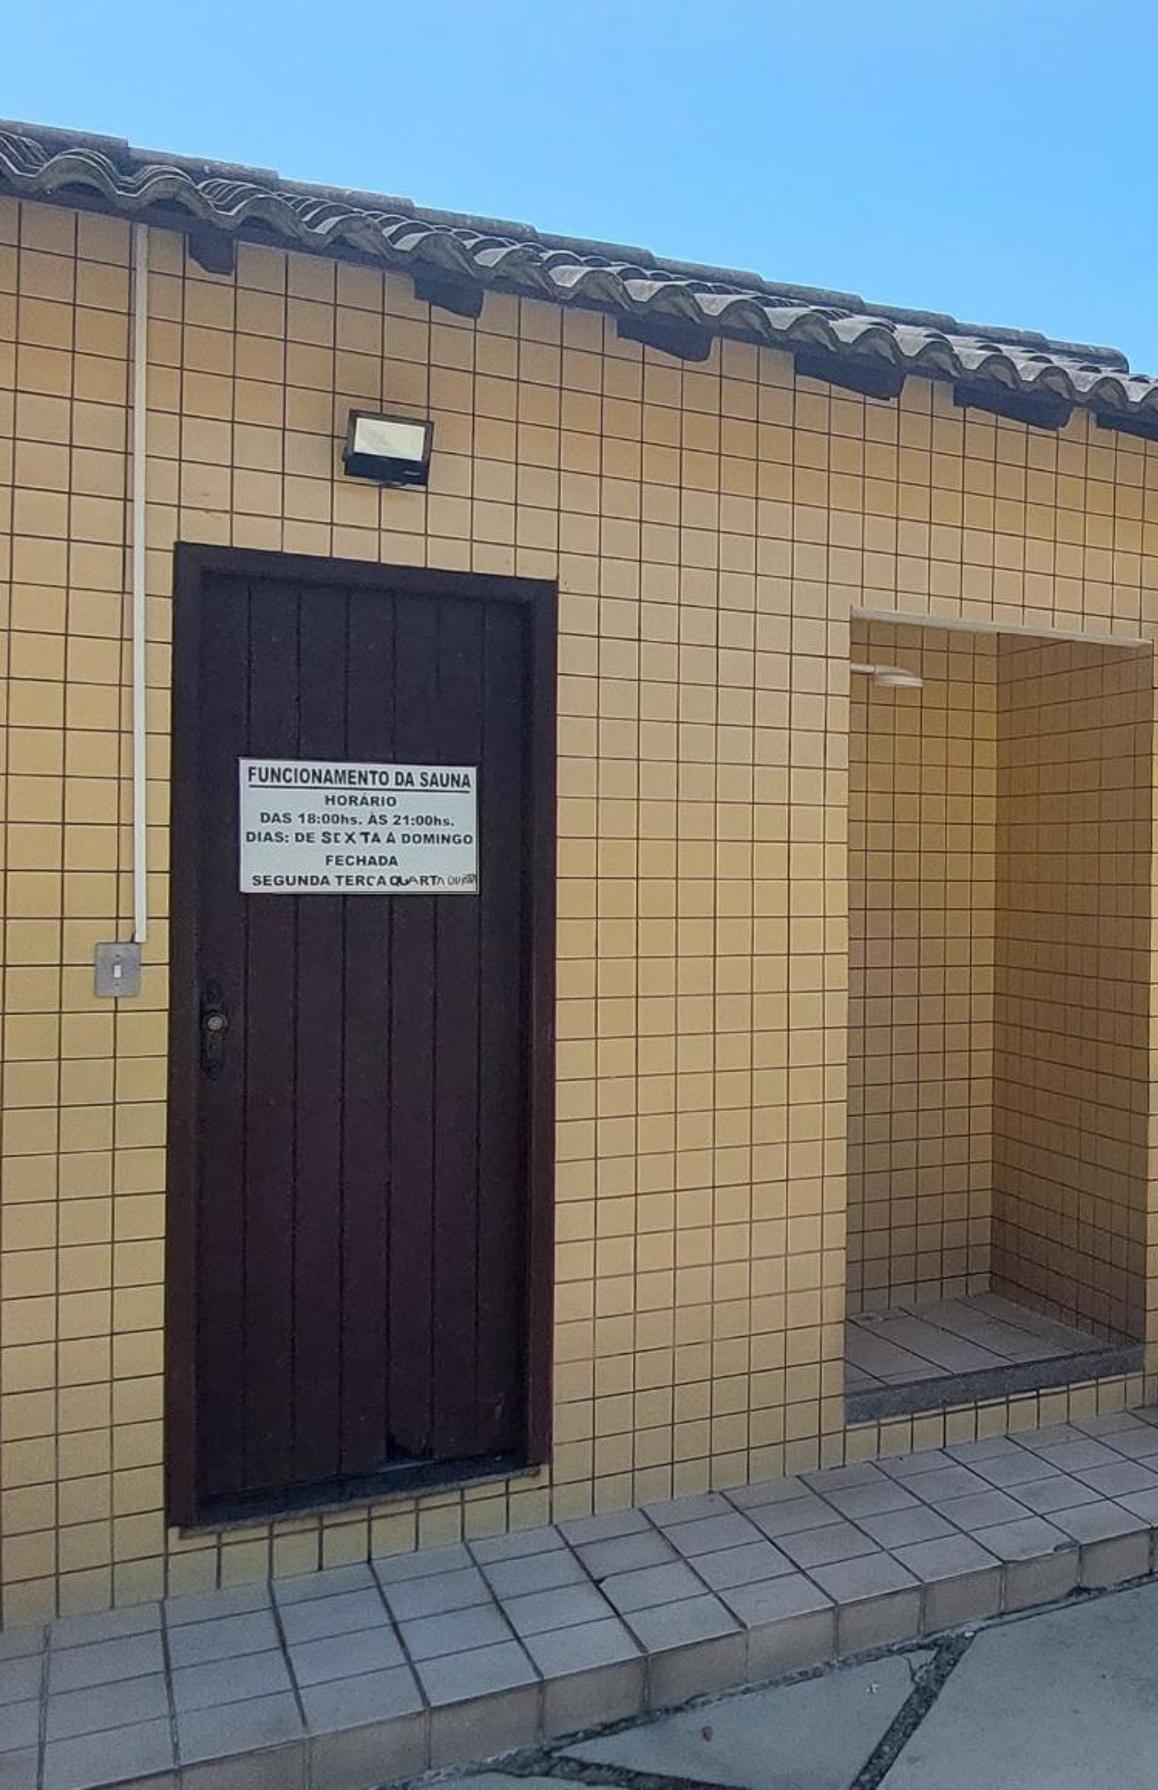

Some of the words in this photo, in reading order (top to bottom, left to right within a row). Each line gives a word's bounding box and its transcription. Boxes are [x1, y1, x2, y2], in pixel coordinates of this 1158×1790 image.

[248, 766, 389, 786] FUNCIONAMENTO
[395, 771, 415, 787] DA
[420, 771, 471, 788] SAUNA
[260, 812, 292, 824] DAS
[298, 813, 362, 825] 18:00hs.
[393, 815, 455, 826] 21:00hs.
[246, 831, 289, 843] DIAS:
[295, 832, 316, 843] DE
[401, 833, 473, 845] DOMINGO
[325, 855, 398, 866] FECHADA
[252, 875, 331, 886] SEGUNDA
